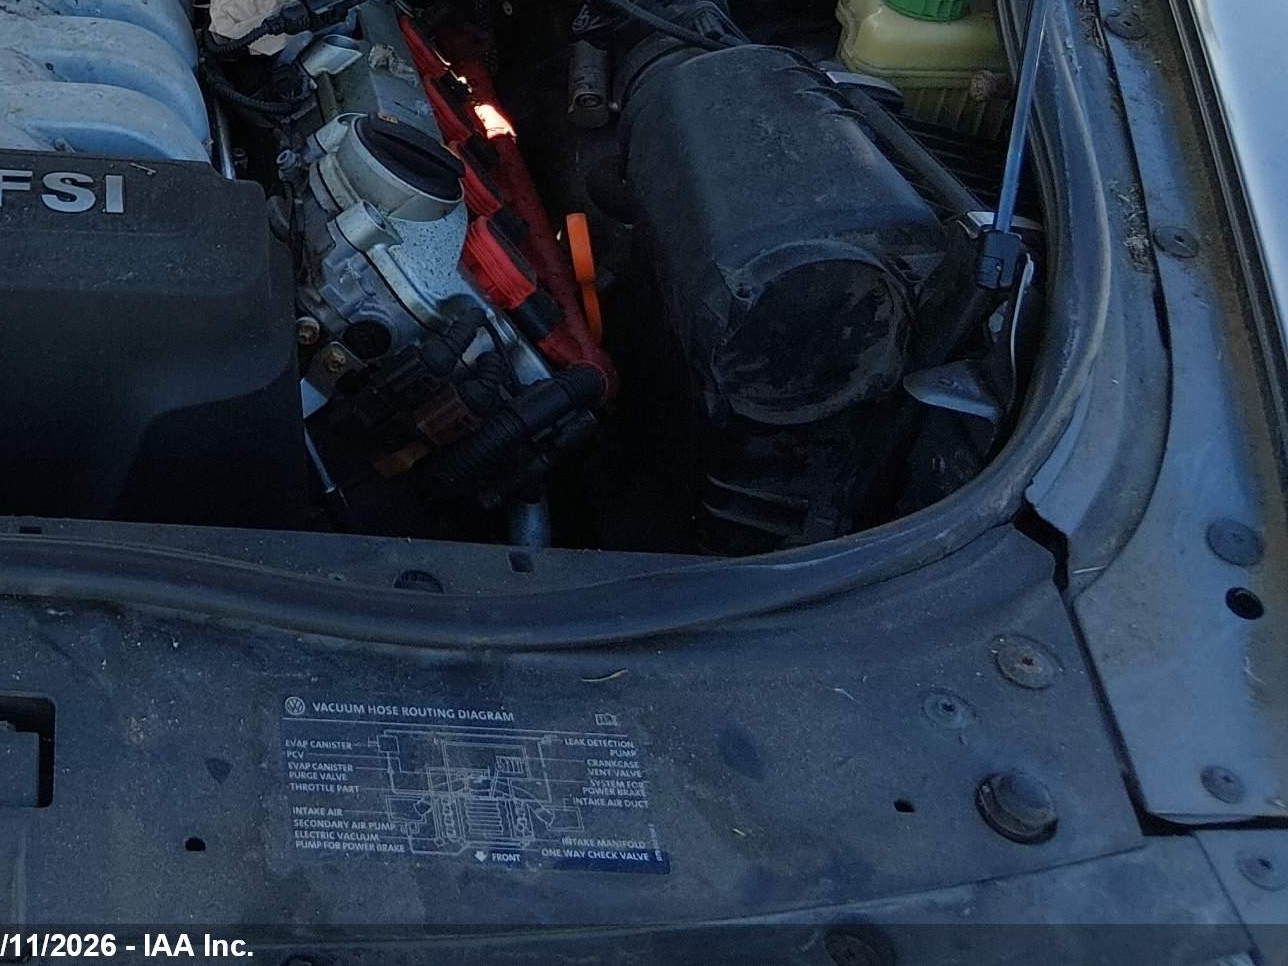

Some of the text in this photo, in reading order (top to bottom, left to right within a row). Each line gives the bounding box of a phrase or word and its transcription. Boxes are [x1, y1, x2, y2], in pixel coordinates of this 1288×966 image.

[312, 702, 365, 715] VACUUM
[368, 705, 399, 716] HOSE
[402, 706, 453, 719] ROUTING
[458, 709, 514, 722] DIAGRAM
[285, 738, 352, 750] EVAP CANISTER
[564, 738, 634, 748] LEAK DETECTION
[286, 751, 304, 759] PCV
[609, 749, 636, 757] PUMP
[288, 762, 353, 772] EVAP CANISTER
[586, 759, 640, 769] CRANKCASE
[289, 772, 347, 781] PURGE VALVE
[587, 768, 642, 778] VENT VALVE
[289, 783, 360, 793] THROTTLE PART
[590, 779, 644, 789] SYSTEM FOR
[582, 787, 615, 795] POWER
[572, 797, 649, 809] INTAKE AIR DUCT
[292, 806, 343, 816] INTAKE AIR
[293, 819, 396, 831] SECONDARY AIR PUMP
[294, 830, 380, 842] ELECTRIC VACUUM
[295, 840, 405, 853] PUMP FOR POWER BRAKE
[562, 837, 646, 849] INTAKE MANIFOLD
[492, 853, 521, 862] FRONT
[542, 848, 650, 861] ONE WAY CHECK VALVE
